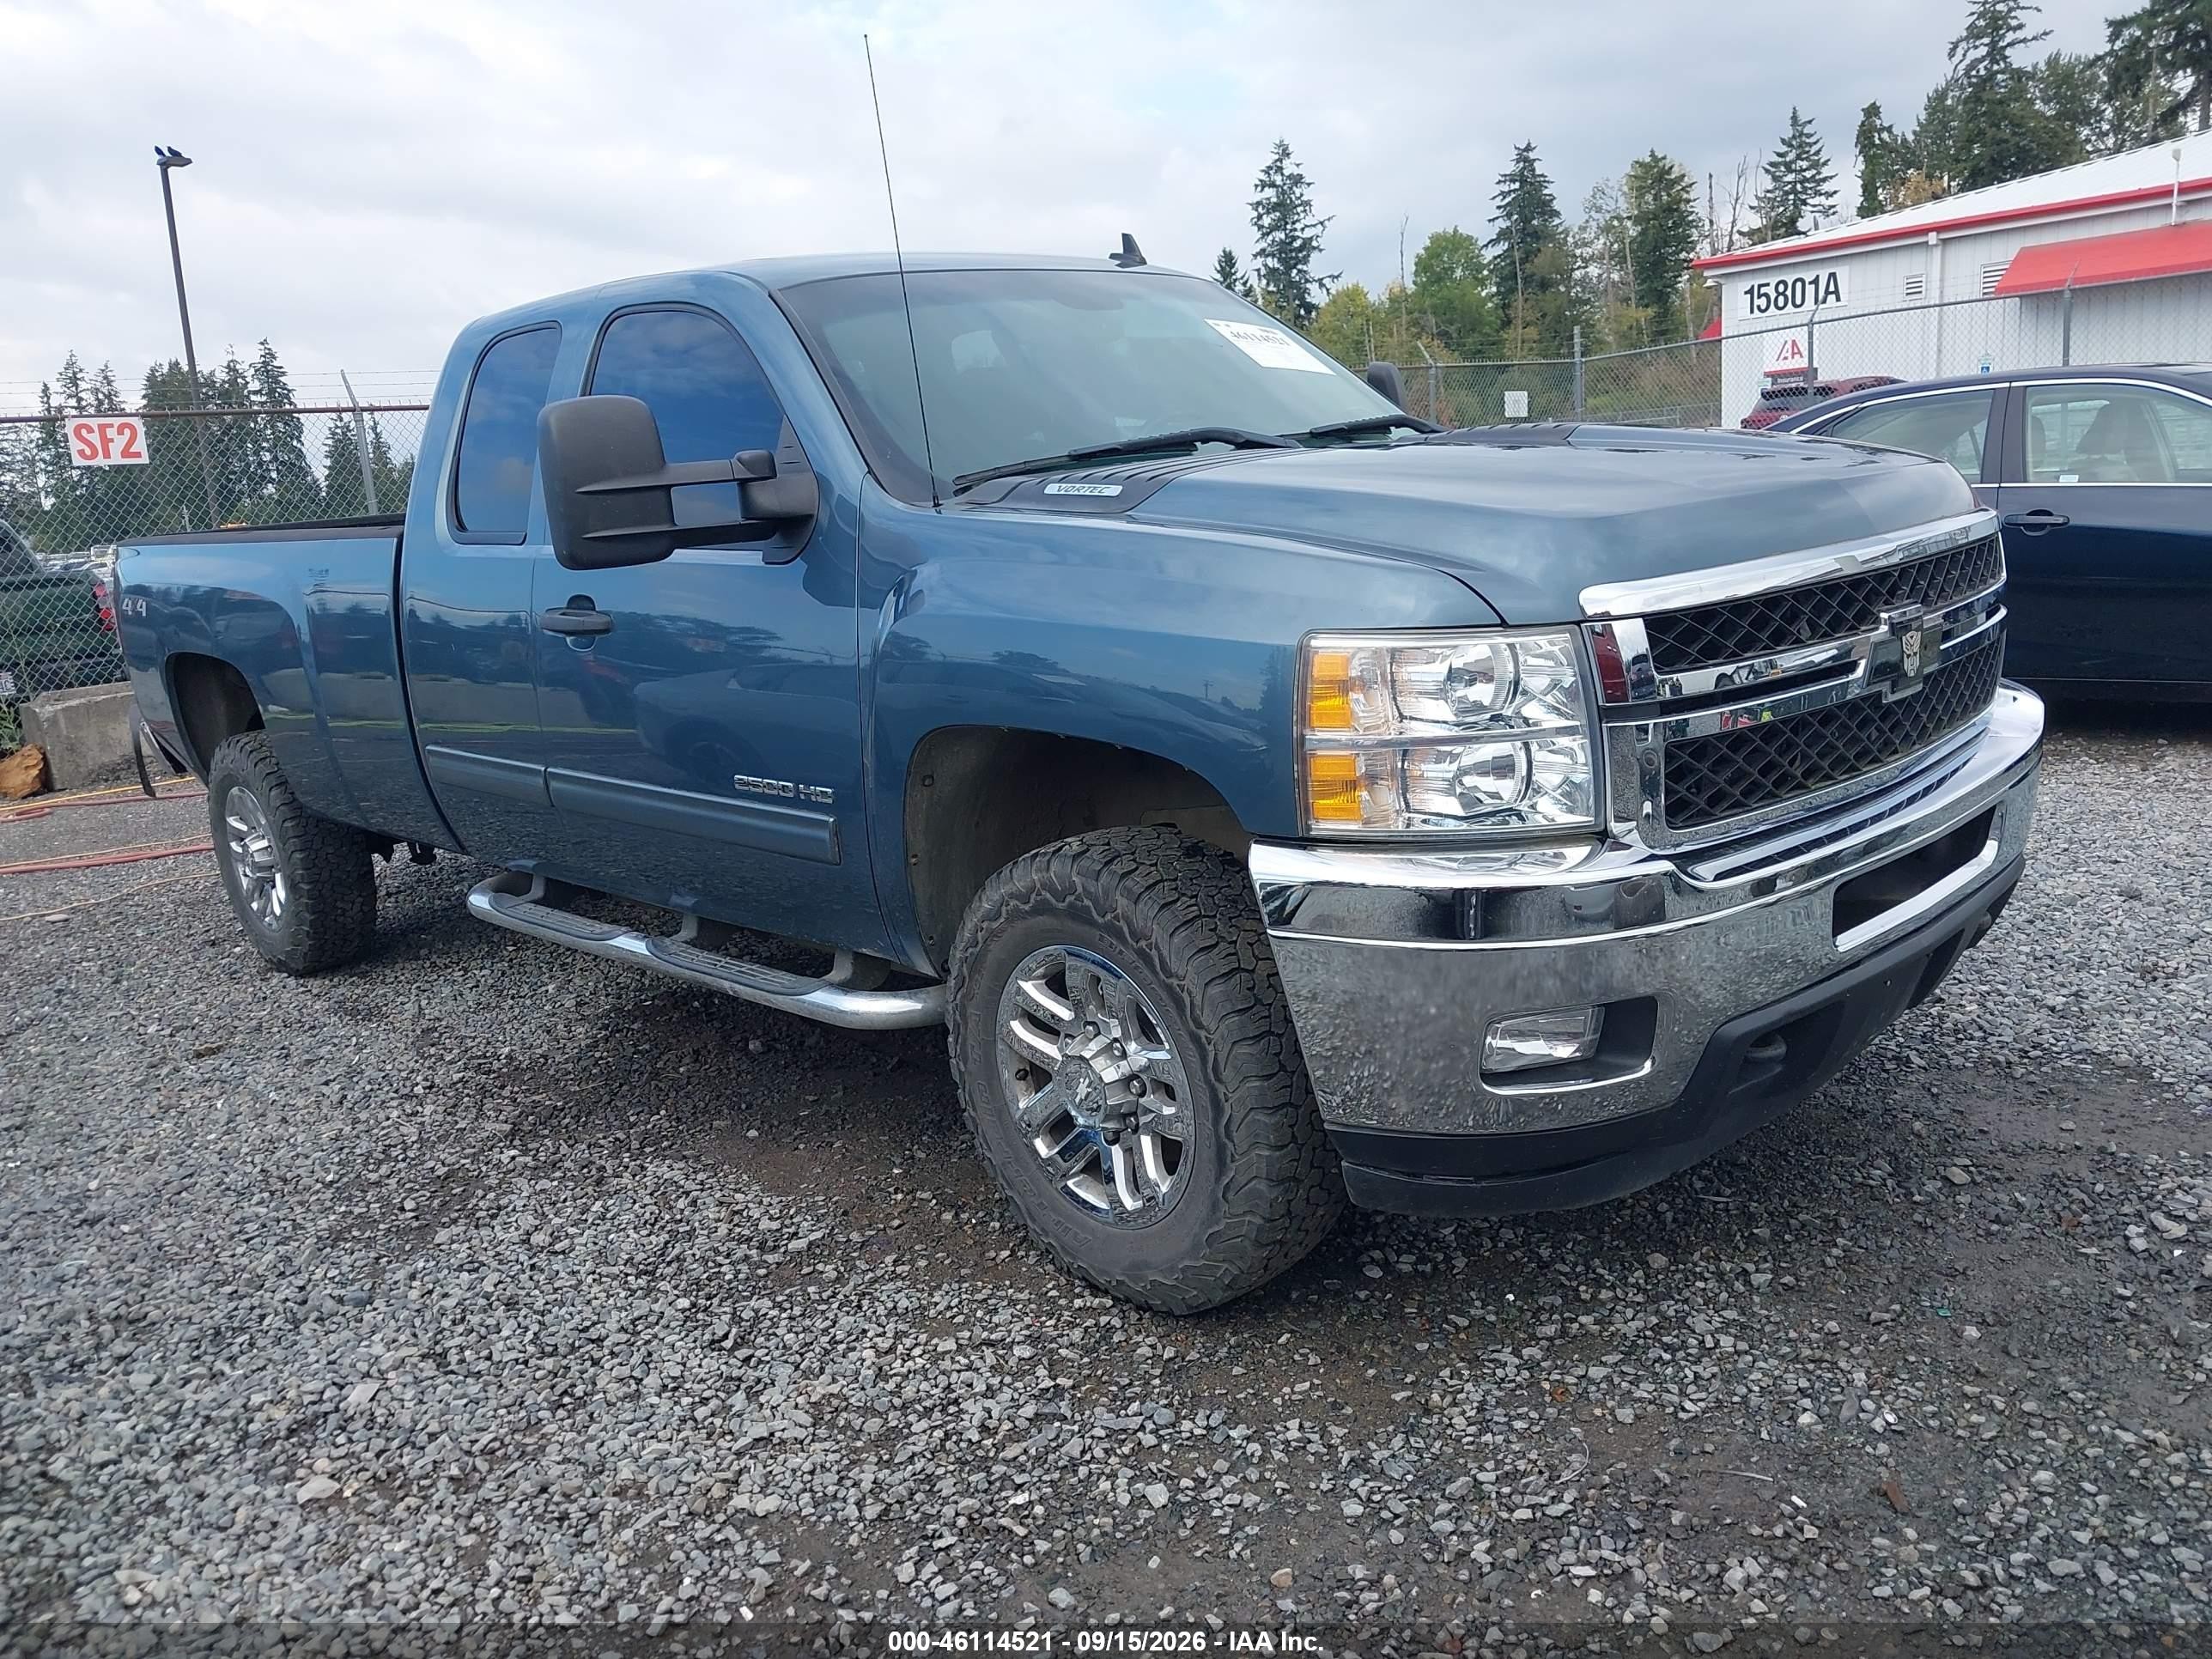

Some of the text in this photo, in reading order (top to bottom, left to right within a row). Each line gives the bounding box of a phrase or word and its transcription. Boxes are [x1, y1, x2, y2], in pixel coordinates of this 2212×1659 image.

[1743, 271, 1842, 315] 15801A
[72, 422, 143, 461] SF2
[1057, 485, 1111, 494] VORTEC
[733, 775, 833, 804] 2500 HD
